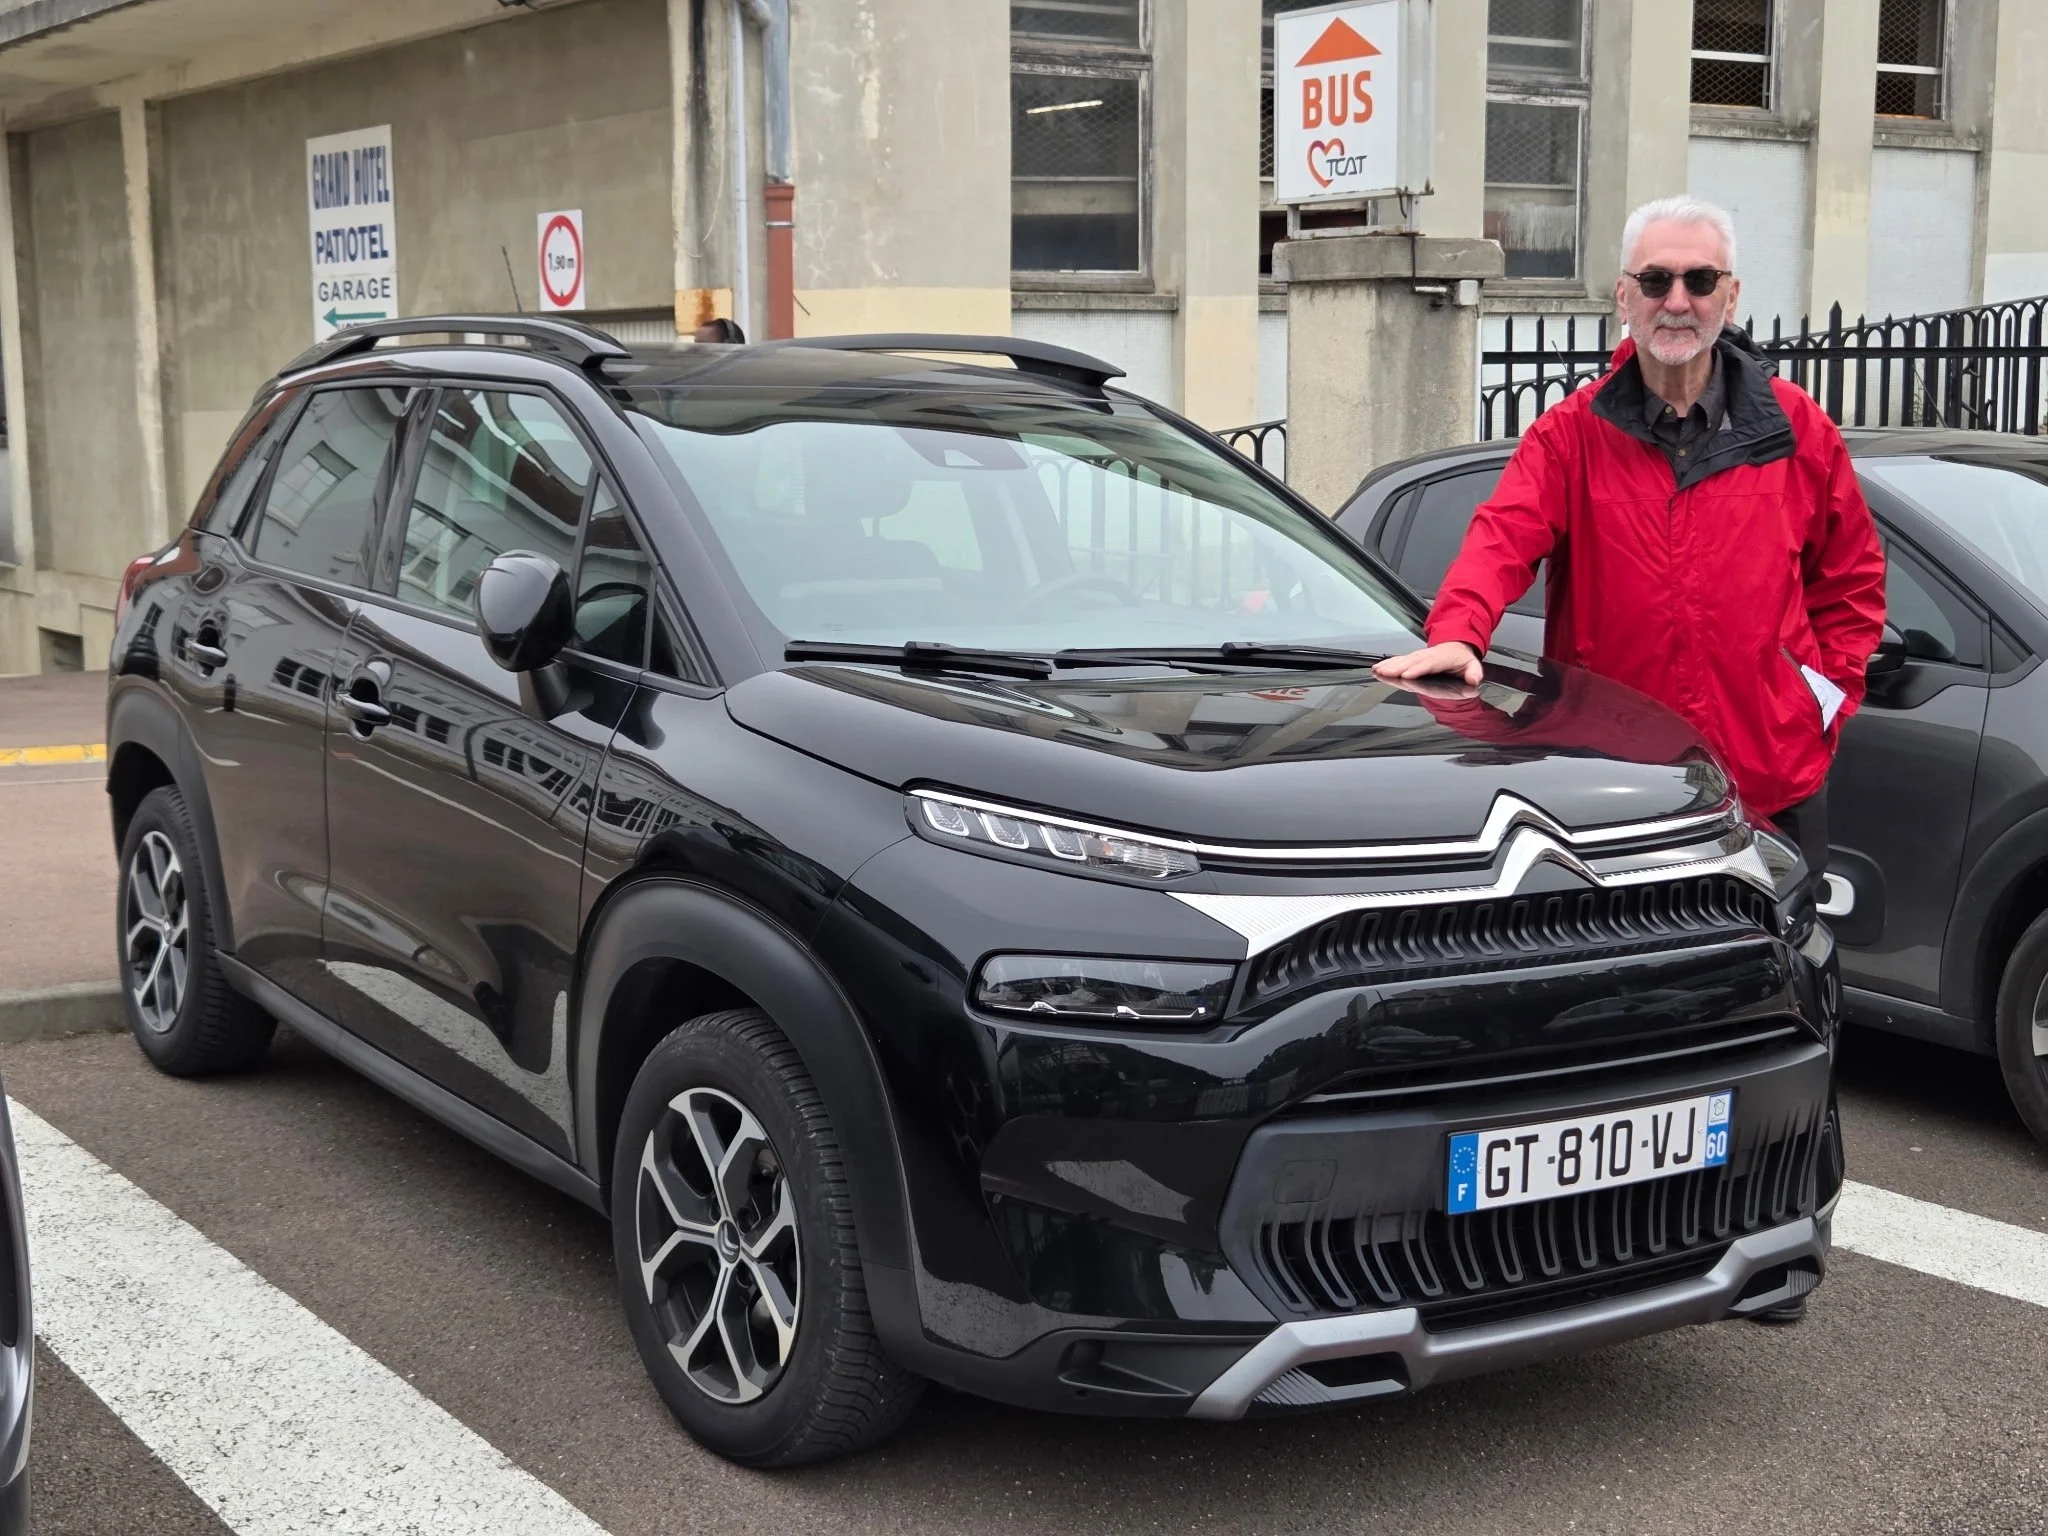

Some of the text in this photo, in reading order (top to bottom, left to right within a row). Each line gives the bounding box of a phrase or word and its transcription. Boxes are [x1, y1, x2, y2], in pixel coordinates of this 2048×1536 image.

[1302, 70, 1373, 130] BUS
[313, 145, 390, 210] GRAND HOTEL
[1326, 155, 1368, 177] TCAT
[315, 223, 389, 265] PATIOTEL
[548, 252, 575, 272] 1,90 m
[318, 277, 391, 302] GARAGE
[1457, 1107, 1728, 1202] F GT-810-VJ 60
